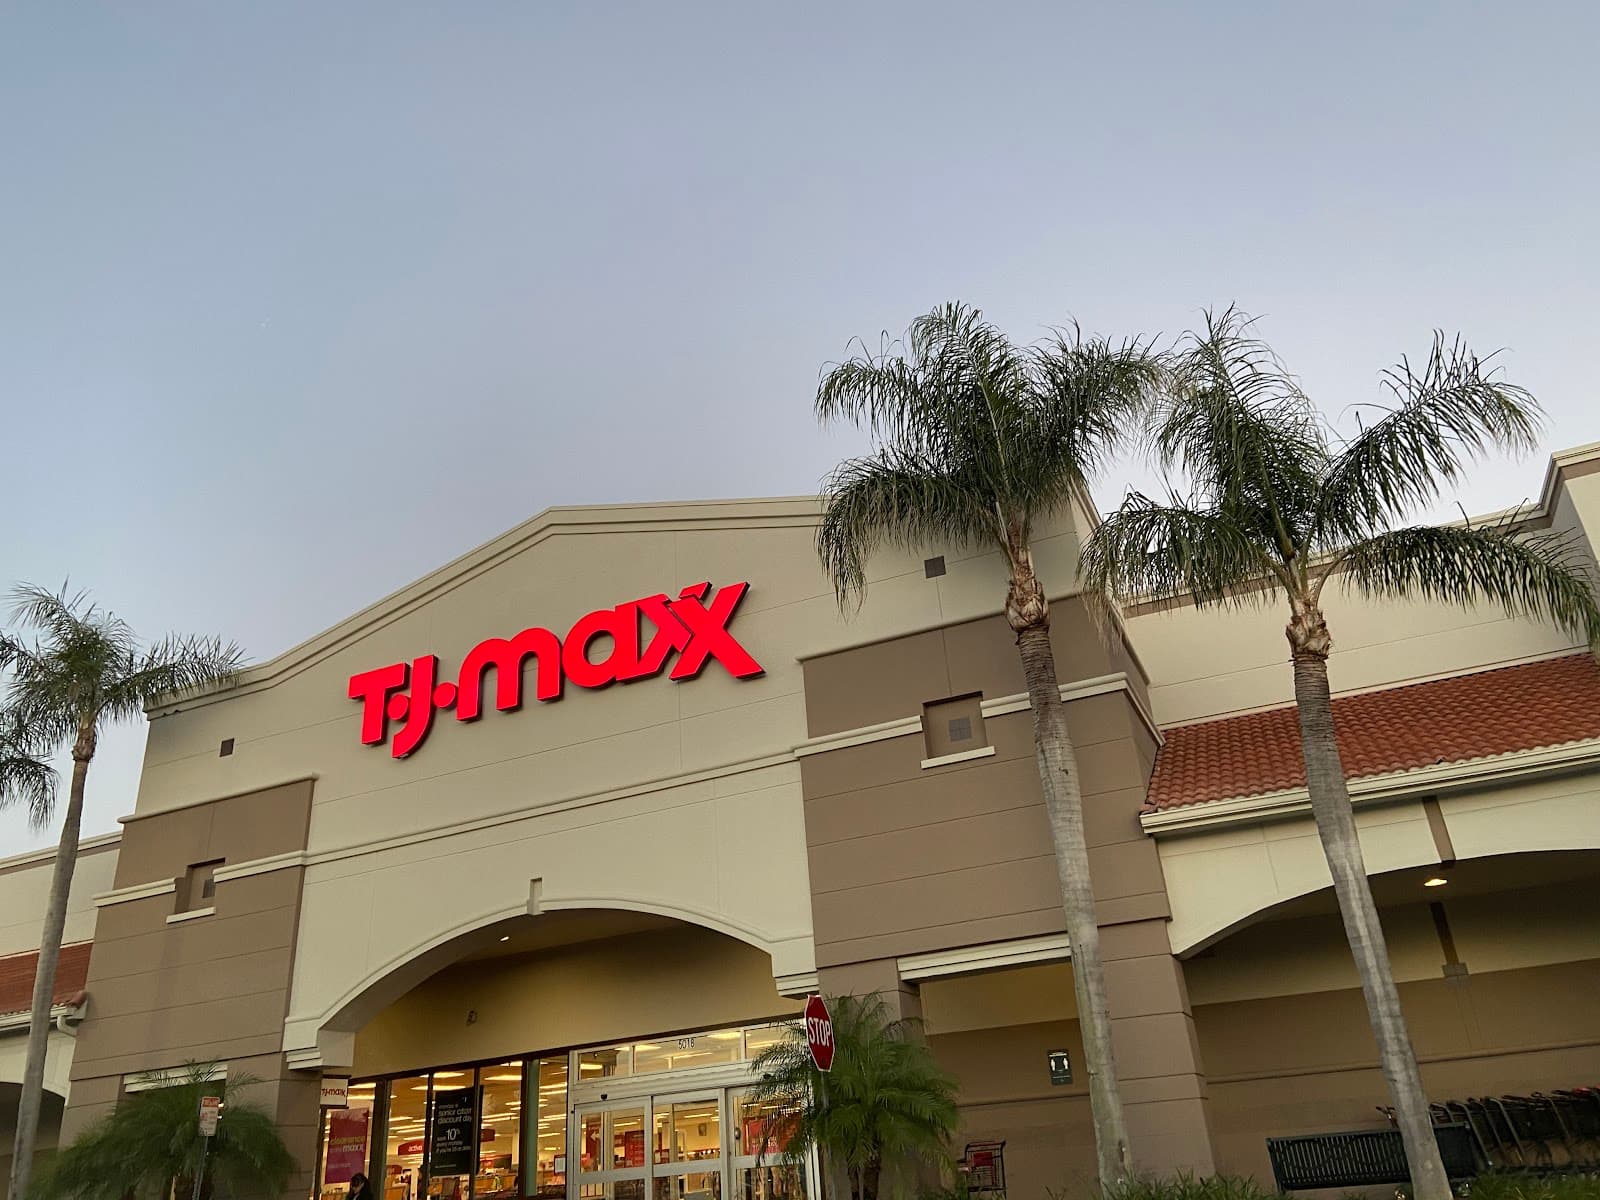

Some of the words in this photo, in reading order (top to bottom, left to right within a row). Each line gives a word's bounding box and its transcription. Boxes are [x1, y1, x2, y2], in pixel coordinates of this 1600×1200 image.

[808, 1016, 831, 1047] STOP
[678, 1038, 695, 1049] 5018
[437, 1115, 462, 1124] discount
